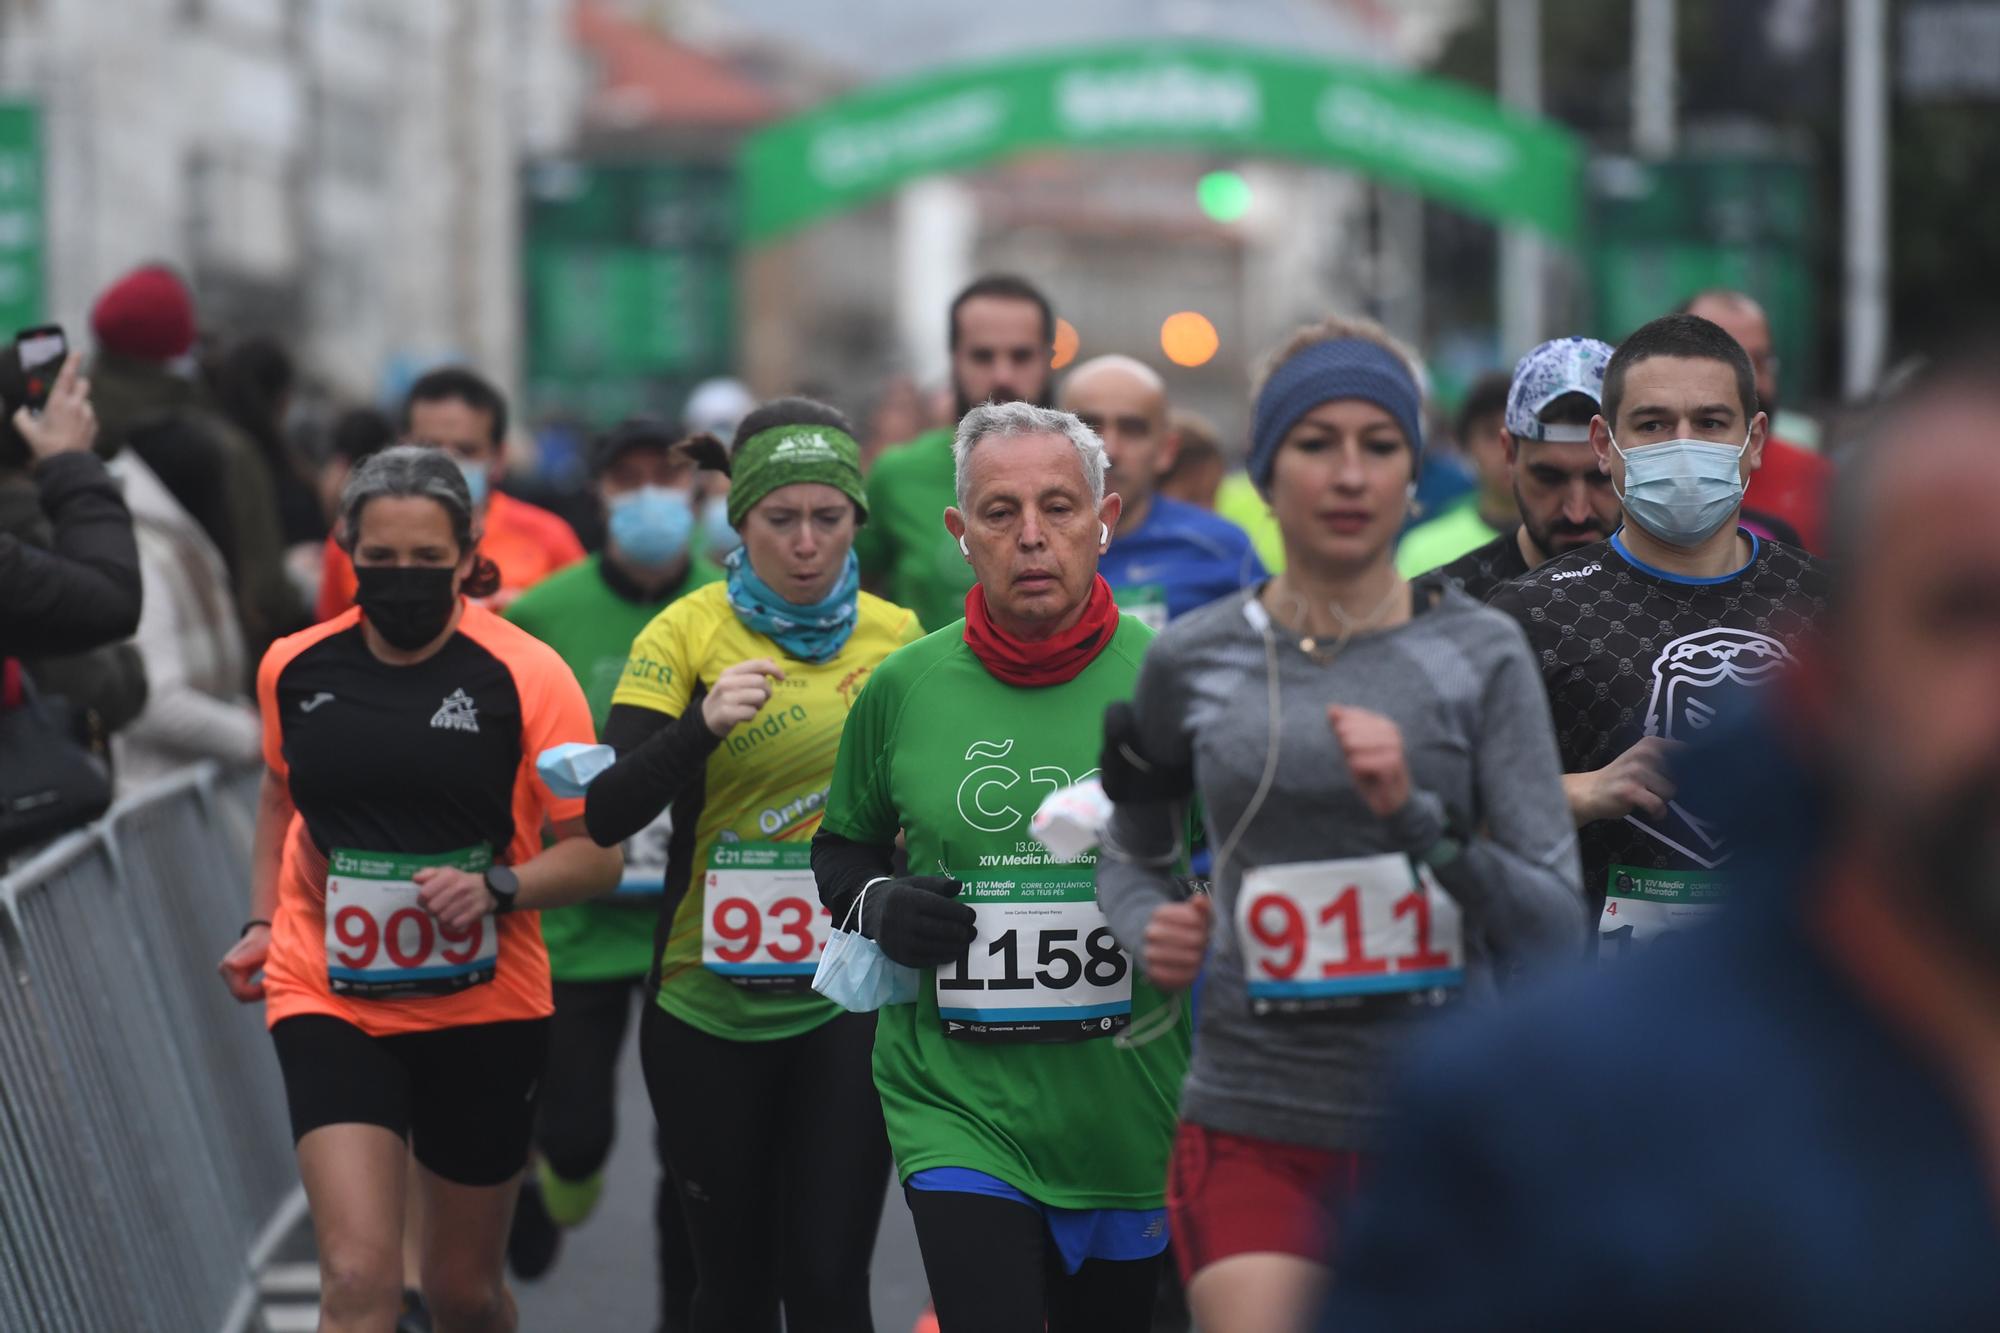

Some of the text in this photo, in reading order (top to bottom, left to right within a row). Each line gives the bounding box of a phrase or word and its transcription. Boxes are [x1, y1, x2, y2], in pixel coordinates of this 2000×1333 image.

[1015, 841, 1049, 853] 13.02.
[979, 856, 1000, 866] XIV
[1002, 853, 1041, 866] Media
[976, 880, 1015, 889] XIV Media
[1658, 880, 1684, 889] Media
[976, 888, 1010, 897] Maratón
[1644, 887, 1679, 897] Maratón
[1606, 902, 1617, 916] 4
[334, 904, 483, 969] 909
[712, 897, 832, 963] 93
[1247, 884, 1451, 981] 911
[939, 926, 1128, 990] 1158
